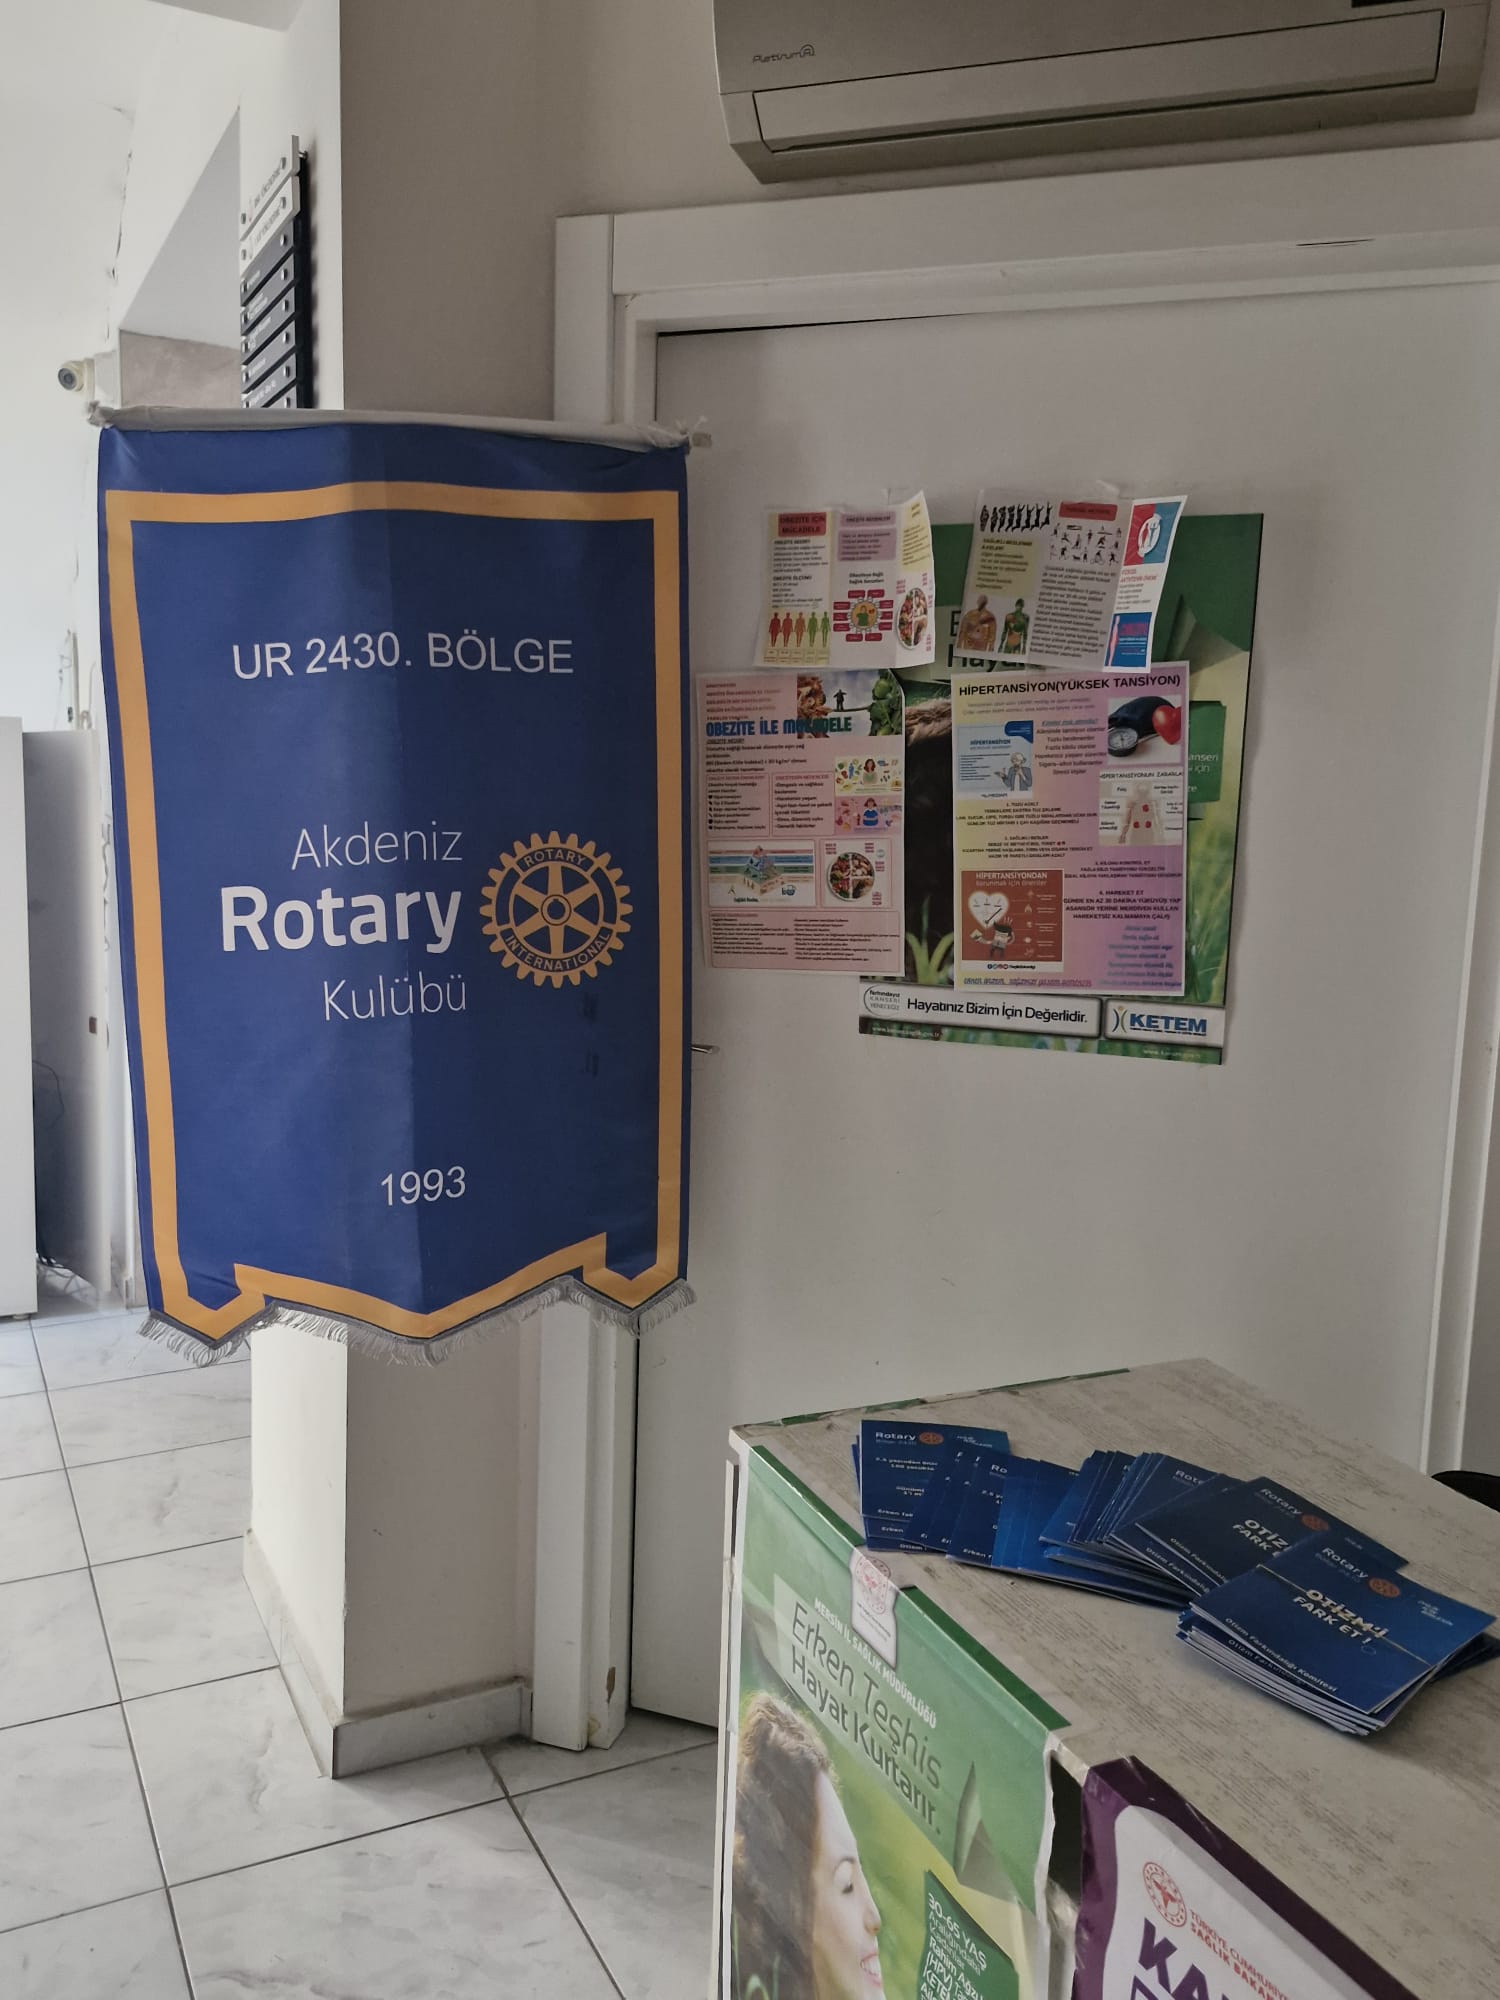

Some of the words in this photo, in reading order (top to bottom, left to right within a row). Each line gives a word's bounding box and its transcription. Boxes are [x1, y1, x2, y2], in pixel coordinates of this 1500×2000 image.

[231, 642, 295, 680] UR
[305, 630, 412, 675] 2430.
[427, 627, 575, 675] BÖLGE
[1113, 674, 1181, 689] TANSİYON)
[760, 716, 779, 735] İLE
[291, 819, 464, 872] Akdeniz
[523, 848, 589, 868] ROTARY
[220, 884, 463, 954] Rotary
[505, 932, 610, 972] INTERNATIONAL
[323, 970, 467, 1023] Kulübü
[907, 997, 964, 1015] Hayatınız
[966, 1002, 1000, 1018] Bizim
[1001, 1002, 1023, 1020] İçin
[1024, 1004, 1088, 1024] Değerlidir.
[1129, 1012, 1207, 1033] KETEM
[380, 1164, 467, 1207] 1993
[875, 1431, 916, 1443] Rotary
[1259, 1488, 1302, 1517] Rotary
[1232, 1524, 1273, 1551] FARK
[1244, 1519, 1291, 1553] OTİZ
[1322, 1547, 1369, 1579] Rotary
[1292, 1596, 1339, 1626] FARK
[1338, 1624, 1363, 1639] ET
[814, 1597, 844, 1636] MERSİN
[852, 1636, 882, 1674] SAĞLIK
[882, 1666, 937, 1730] MÜDÜRLÜĞÜ
[792, 1601, 855, 1698] Erken
[863, 1671, 943, 1791] Teşhis
[792, 1644, 849, 1734] Hayat
[853, 1716, 942, 1837] Kurtarır.
[928, 1892, 961, 1940] 30-65
[1190, 1908, 1229, 1953] TÜRKİYE
[1190, 1921, 1231, 1967] SAĞLIK
